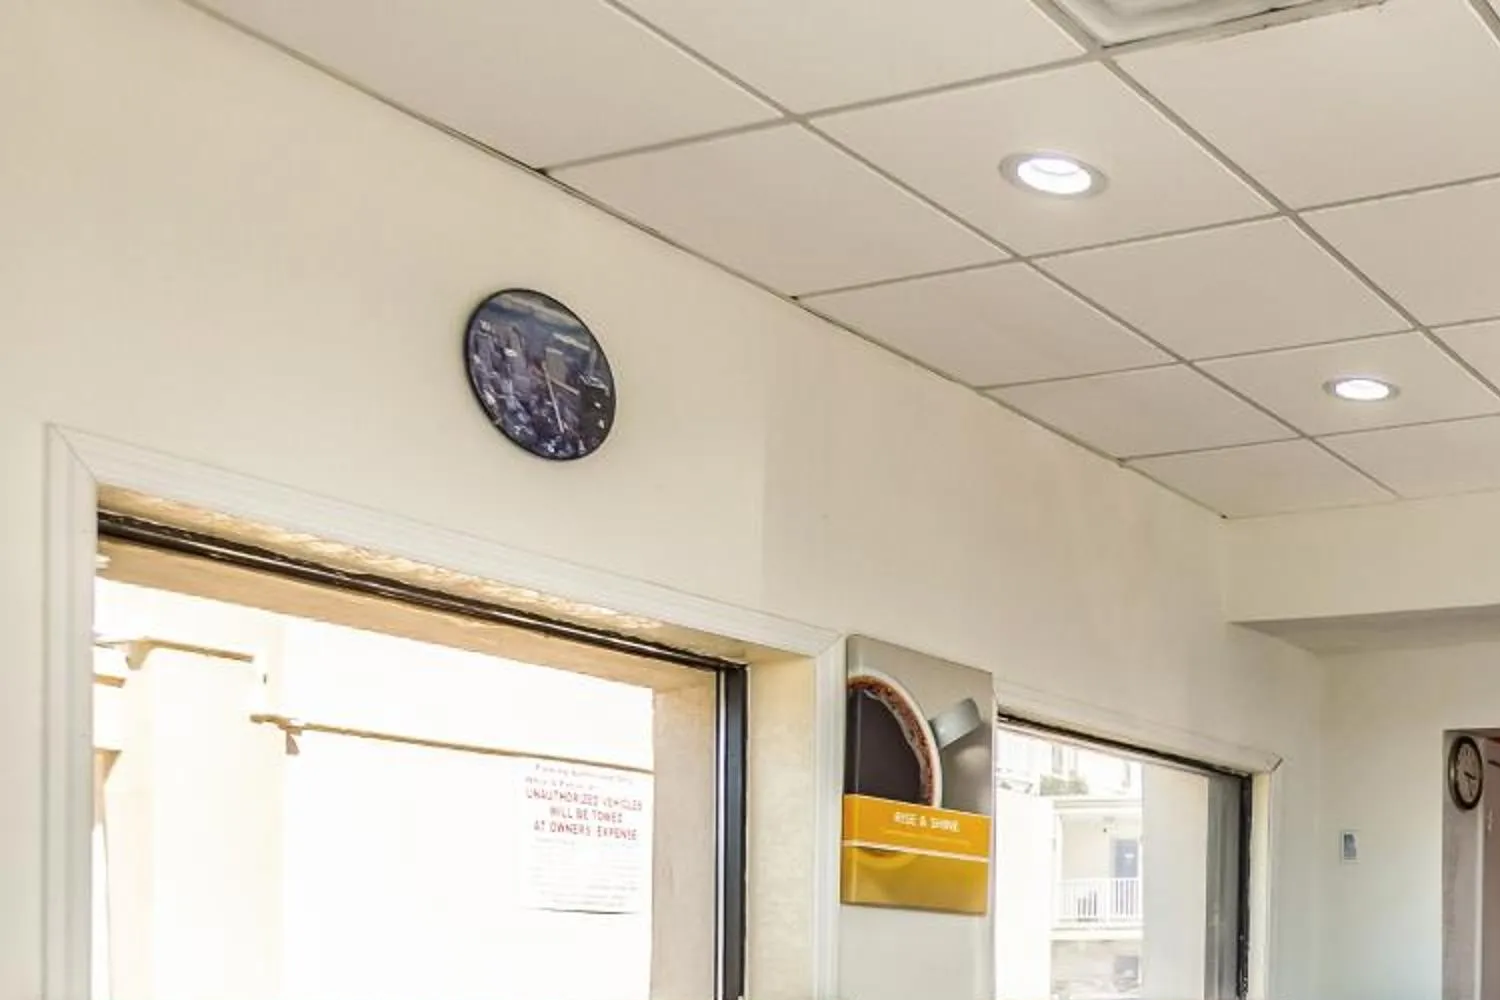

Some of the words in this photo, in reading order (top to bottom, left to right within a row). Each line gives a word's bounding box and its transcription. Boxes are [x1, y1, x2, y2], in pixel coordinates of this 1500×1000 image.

[525, 787, 599, 807] UNAUTHORIZED
[602, 796, 643, 812] VEHICLES
[549, 805, 574, 820] WILL
[575, 807, 589, 821] BE
[591, 809, 624, 825] TOWED
[894, 811, 917, 827] RISE
[919, 815, 928, 828] &
[930, 817, 961, 833] SHINE
[533, 819, 546, 831] AT
[596, 825, 638, 841] EXPENSE
